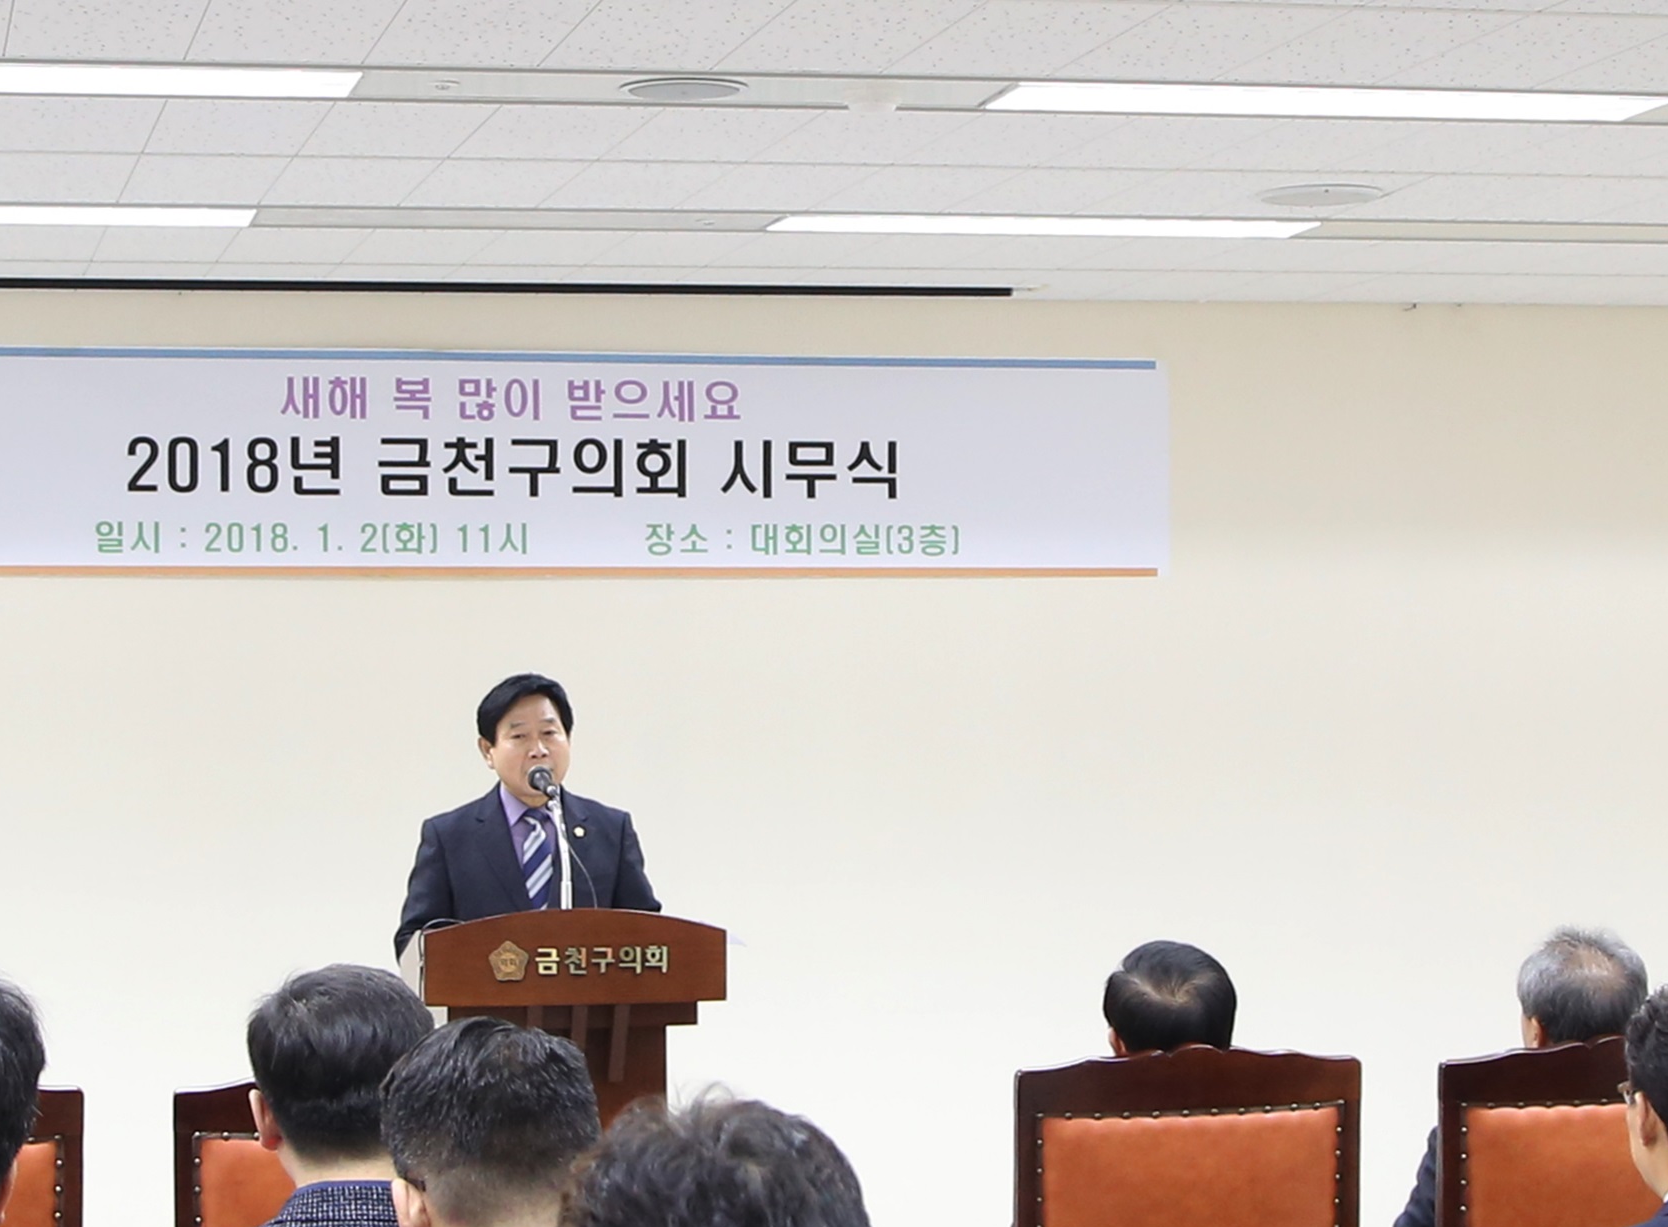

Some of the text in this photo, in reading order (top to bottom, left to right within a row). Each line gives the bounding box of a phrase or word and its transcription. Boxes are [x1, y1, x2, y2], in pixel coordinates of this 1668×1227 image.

[281, 376, 741, 422] 새해 복 많이 받으세요
[127, 436, 898, 499] 2018년 금천구의회 시무식
[95, 521, 161, 554] 일시
[204, 522, 298, 552] 2018.
[317, 523, 343, 552] 1.
[457, 522, 528, 554] 11시
[644, 523, 709, 555] 장소
[750, 523, 961, 557] 대회의실(3층)
[534, 945, 669, 976] 금천구의회
